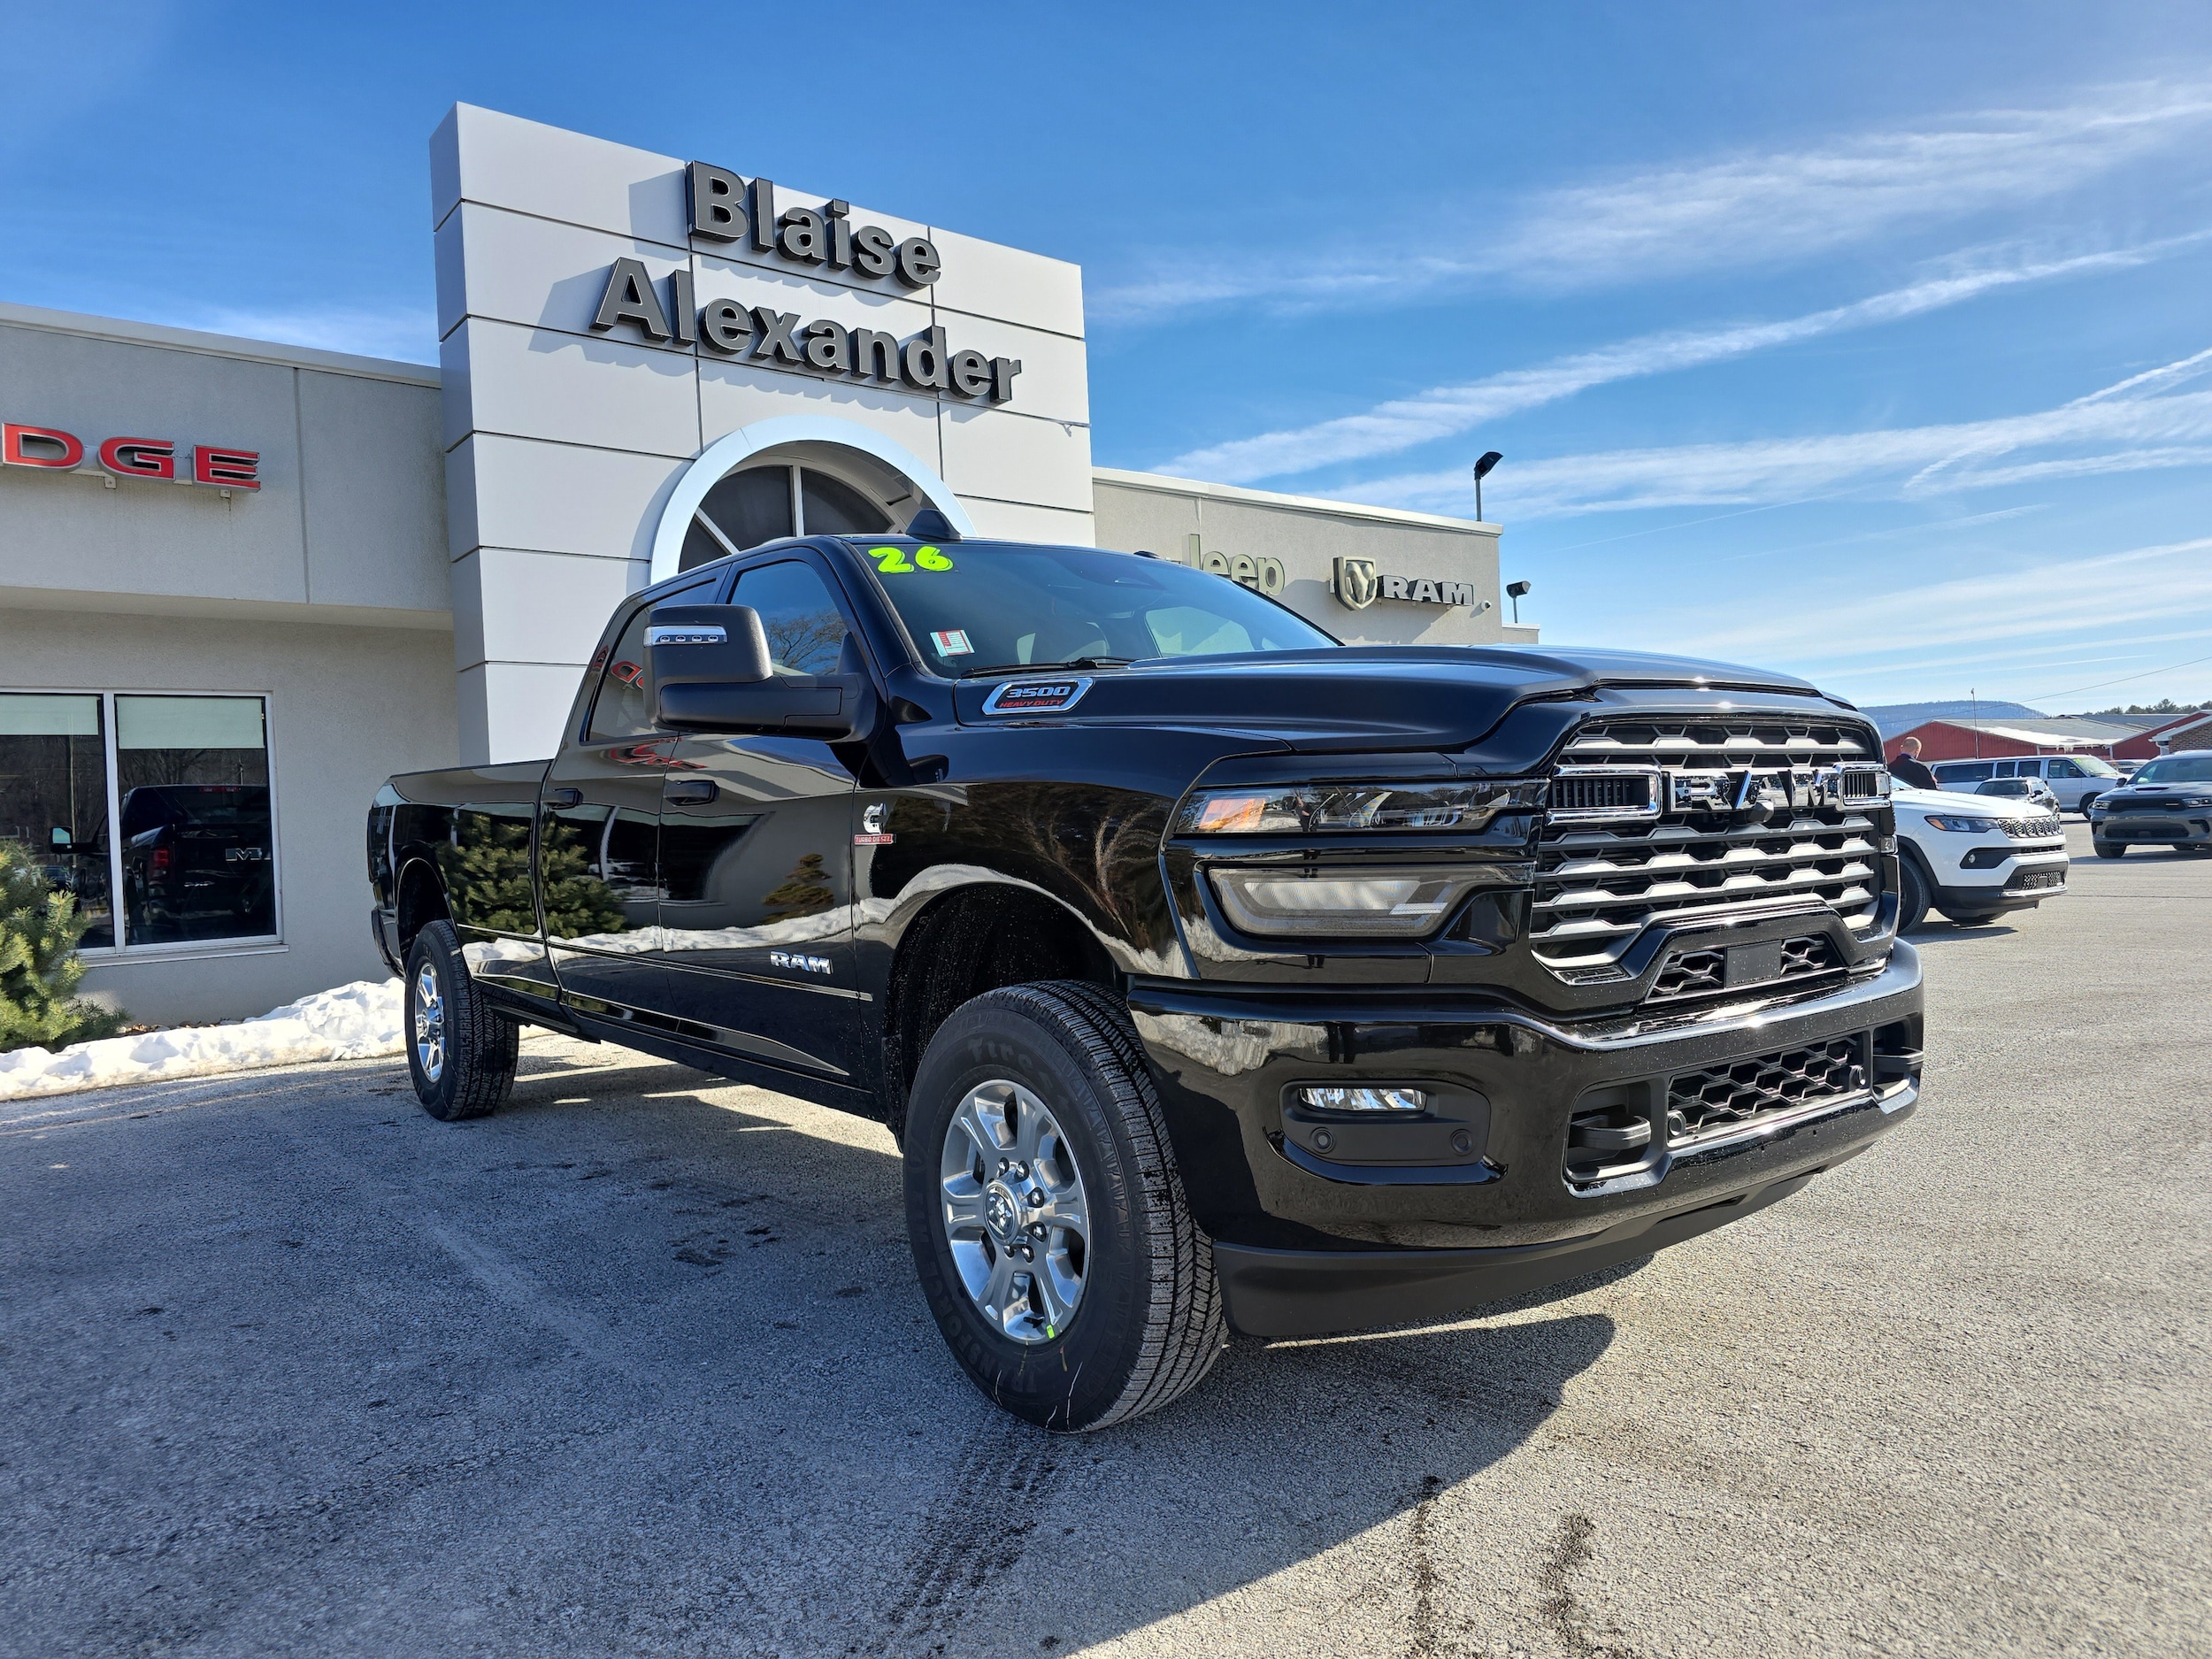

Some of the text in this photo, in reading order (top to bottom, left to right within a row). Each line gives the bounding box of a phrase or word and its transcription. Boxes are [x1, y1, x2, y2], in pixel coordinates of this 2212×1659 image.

[686, 160, 941, 289] Blaise
[590, 257, 1022, 403] Alexander
[868, 546, 954, 572] 26
[1380, 575, 1474, 606] RAM
[1006, 686, 1071, 698] 3500
[1664, 768, 1843, 812] RAM
[771, 950, 833, 975] RAM
